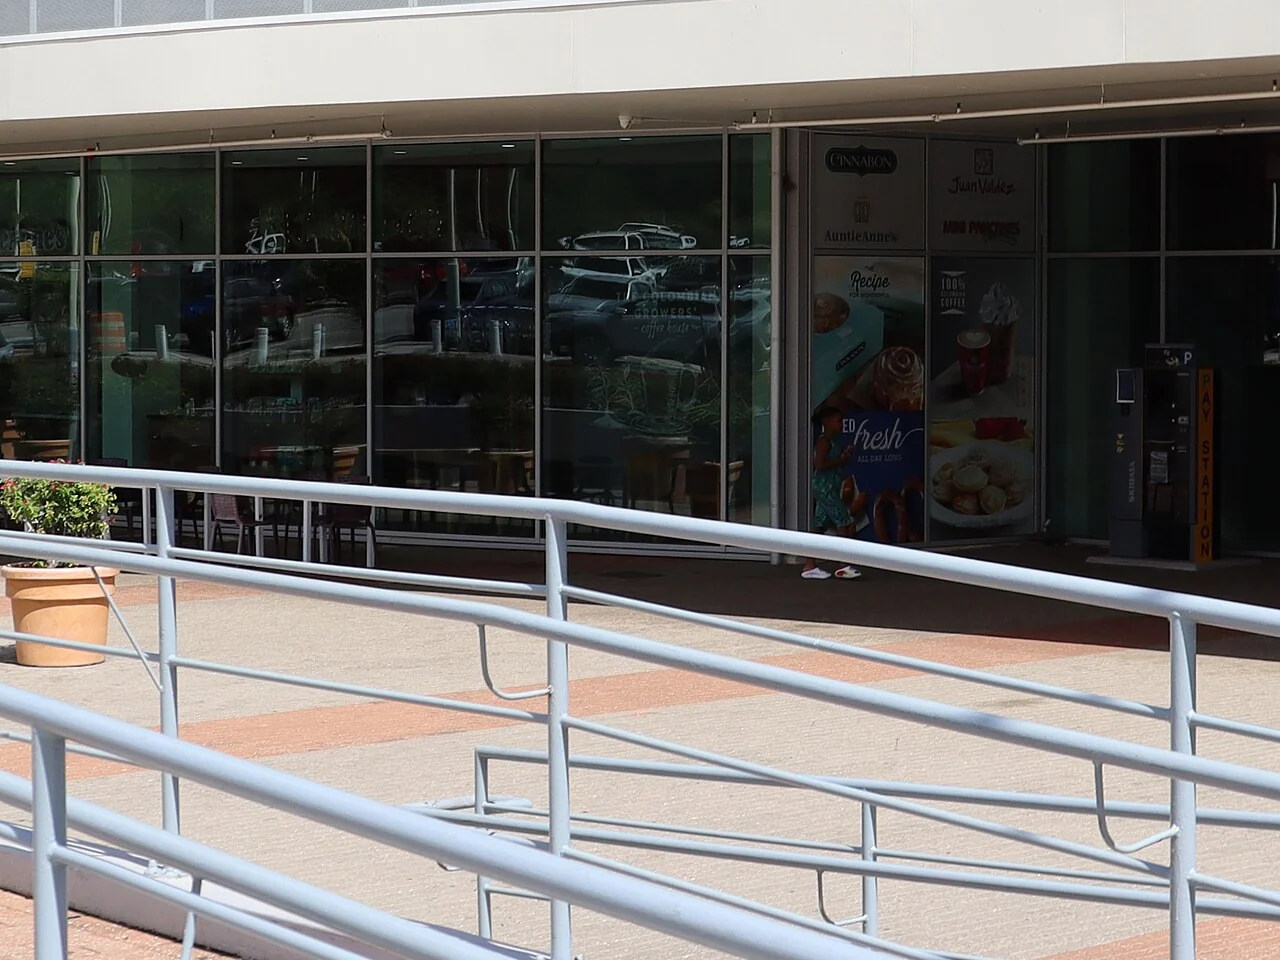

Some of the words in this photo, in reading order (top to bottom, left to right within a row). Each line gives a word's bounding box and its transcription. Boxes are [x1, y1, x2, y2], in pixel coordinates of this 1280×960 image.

[830, 151, 892, 169] CINNABON
[948, 176, 977, 194] Juan
[851, 270, 890, 293] Recipe
[941, 278, 966, 290] 100%
[940, 297, 966, 308] COFFEE
[1202, 373, 1211, 422] PAY
[854, 417, 924, 451] fresh
[1201, 440, 1211, 557] STATION
